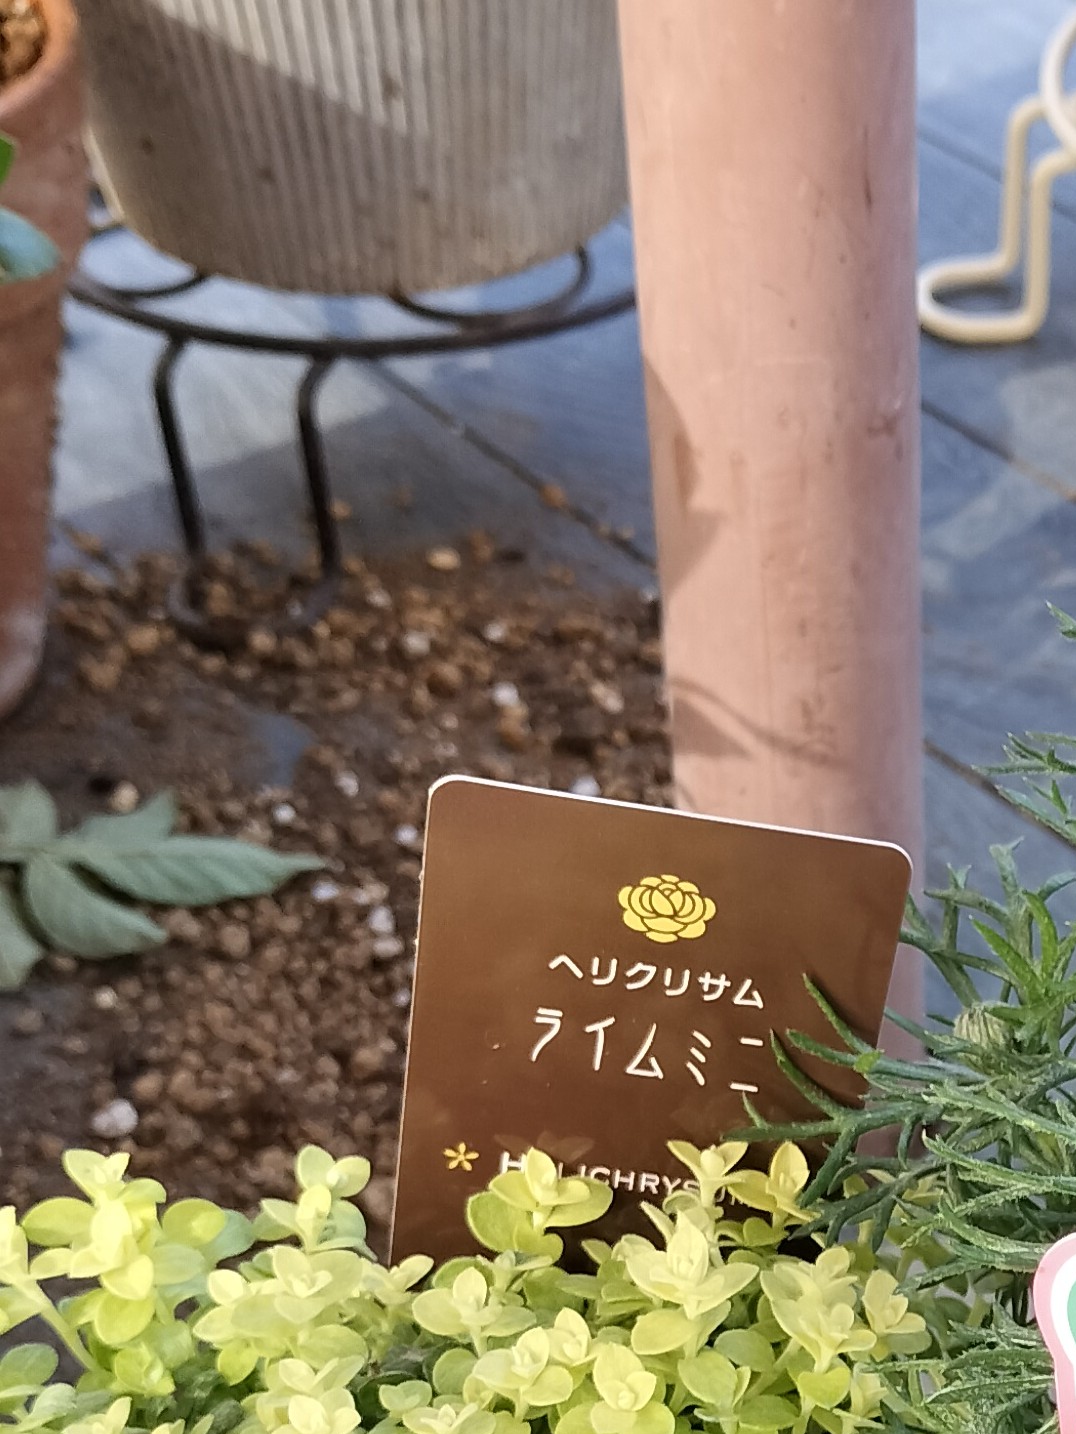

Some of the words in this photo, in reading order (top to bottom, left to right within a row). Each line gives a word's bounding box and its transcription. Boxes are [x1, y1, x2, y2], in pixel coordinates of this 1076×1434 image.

[548, 953, 764, 1010] ヘリクリサム
[530, 1006, 764, 1094] ライムミニ
[499, 1151, 747, 1207] HICHRYS
